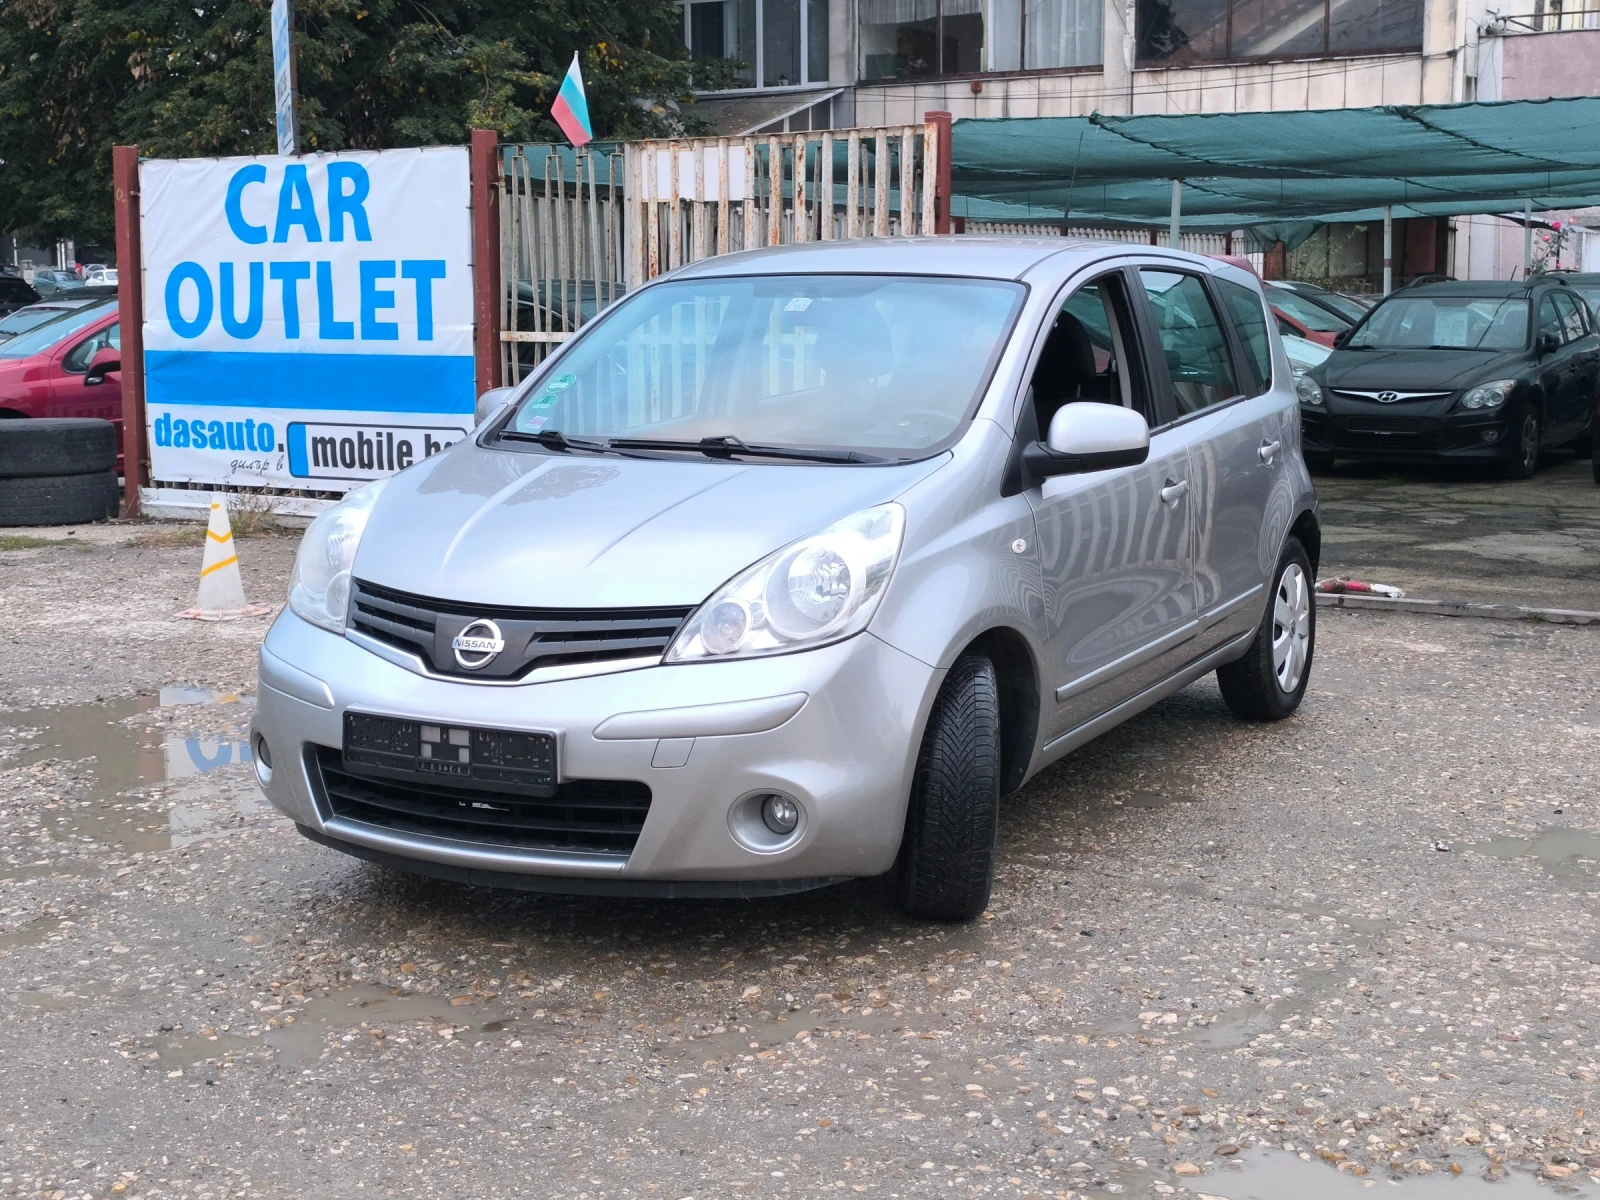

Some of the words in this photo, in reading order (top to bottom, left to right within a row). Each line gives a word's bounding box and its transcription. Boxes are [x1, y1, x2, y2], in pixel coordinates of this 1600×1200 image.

[224, 161, 372, 244] CAR
[164, 260, 446, 341] OUTLET
[154, 412, 285, 453] dasauto.
[454, 638, 497, 650] NISSAN
